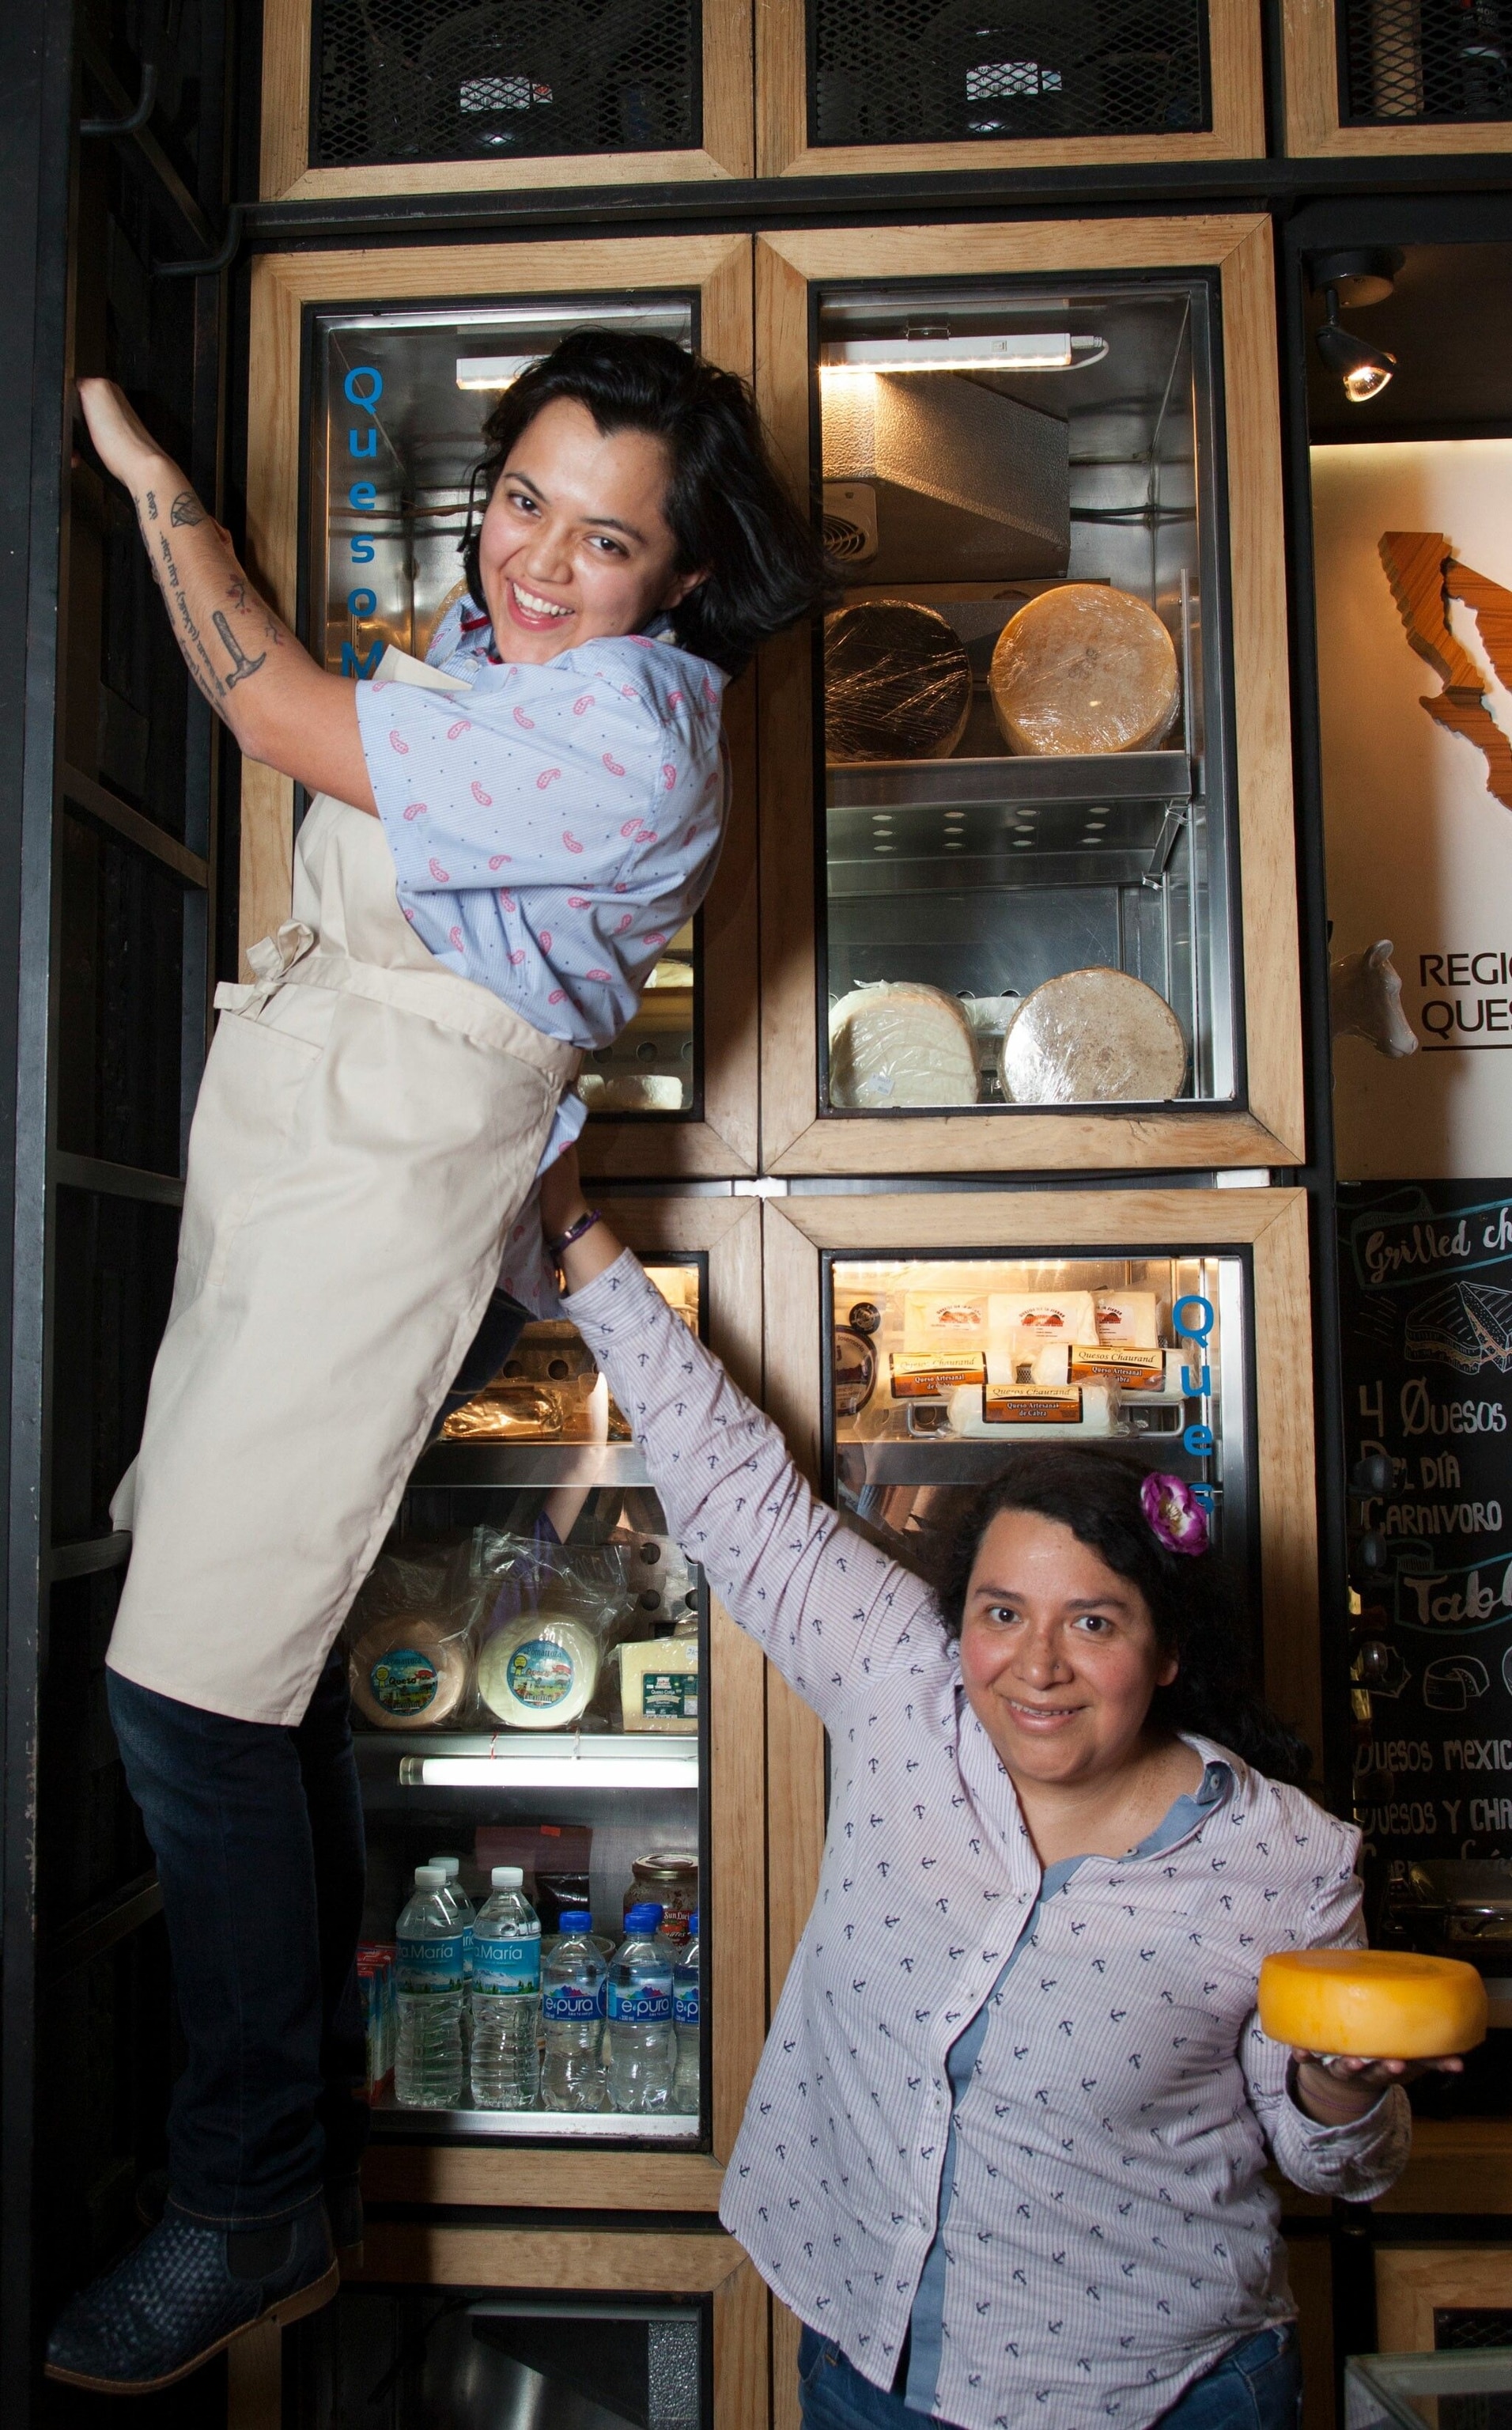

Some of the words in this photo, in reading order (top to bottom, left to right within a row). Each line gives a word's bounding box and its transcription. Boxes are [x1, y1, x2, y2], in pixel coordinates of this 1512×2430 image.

[1419, 952, 1512, 987] REGI
[1421, 998, 1512, 1041] QUE
[1365, 1219, 1471, 1284] Grilled
[1079, 1351, 1109, 1360] Quesos
[1111, 1353, 1156, 1363] Chaurand
[1359, 1380, 1385, 1437] 4
[1442, 1800, 1462, 1834] Y
[481, 1944, 523, 1960] María
